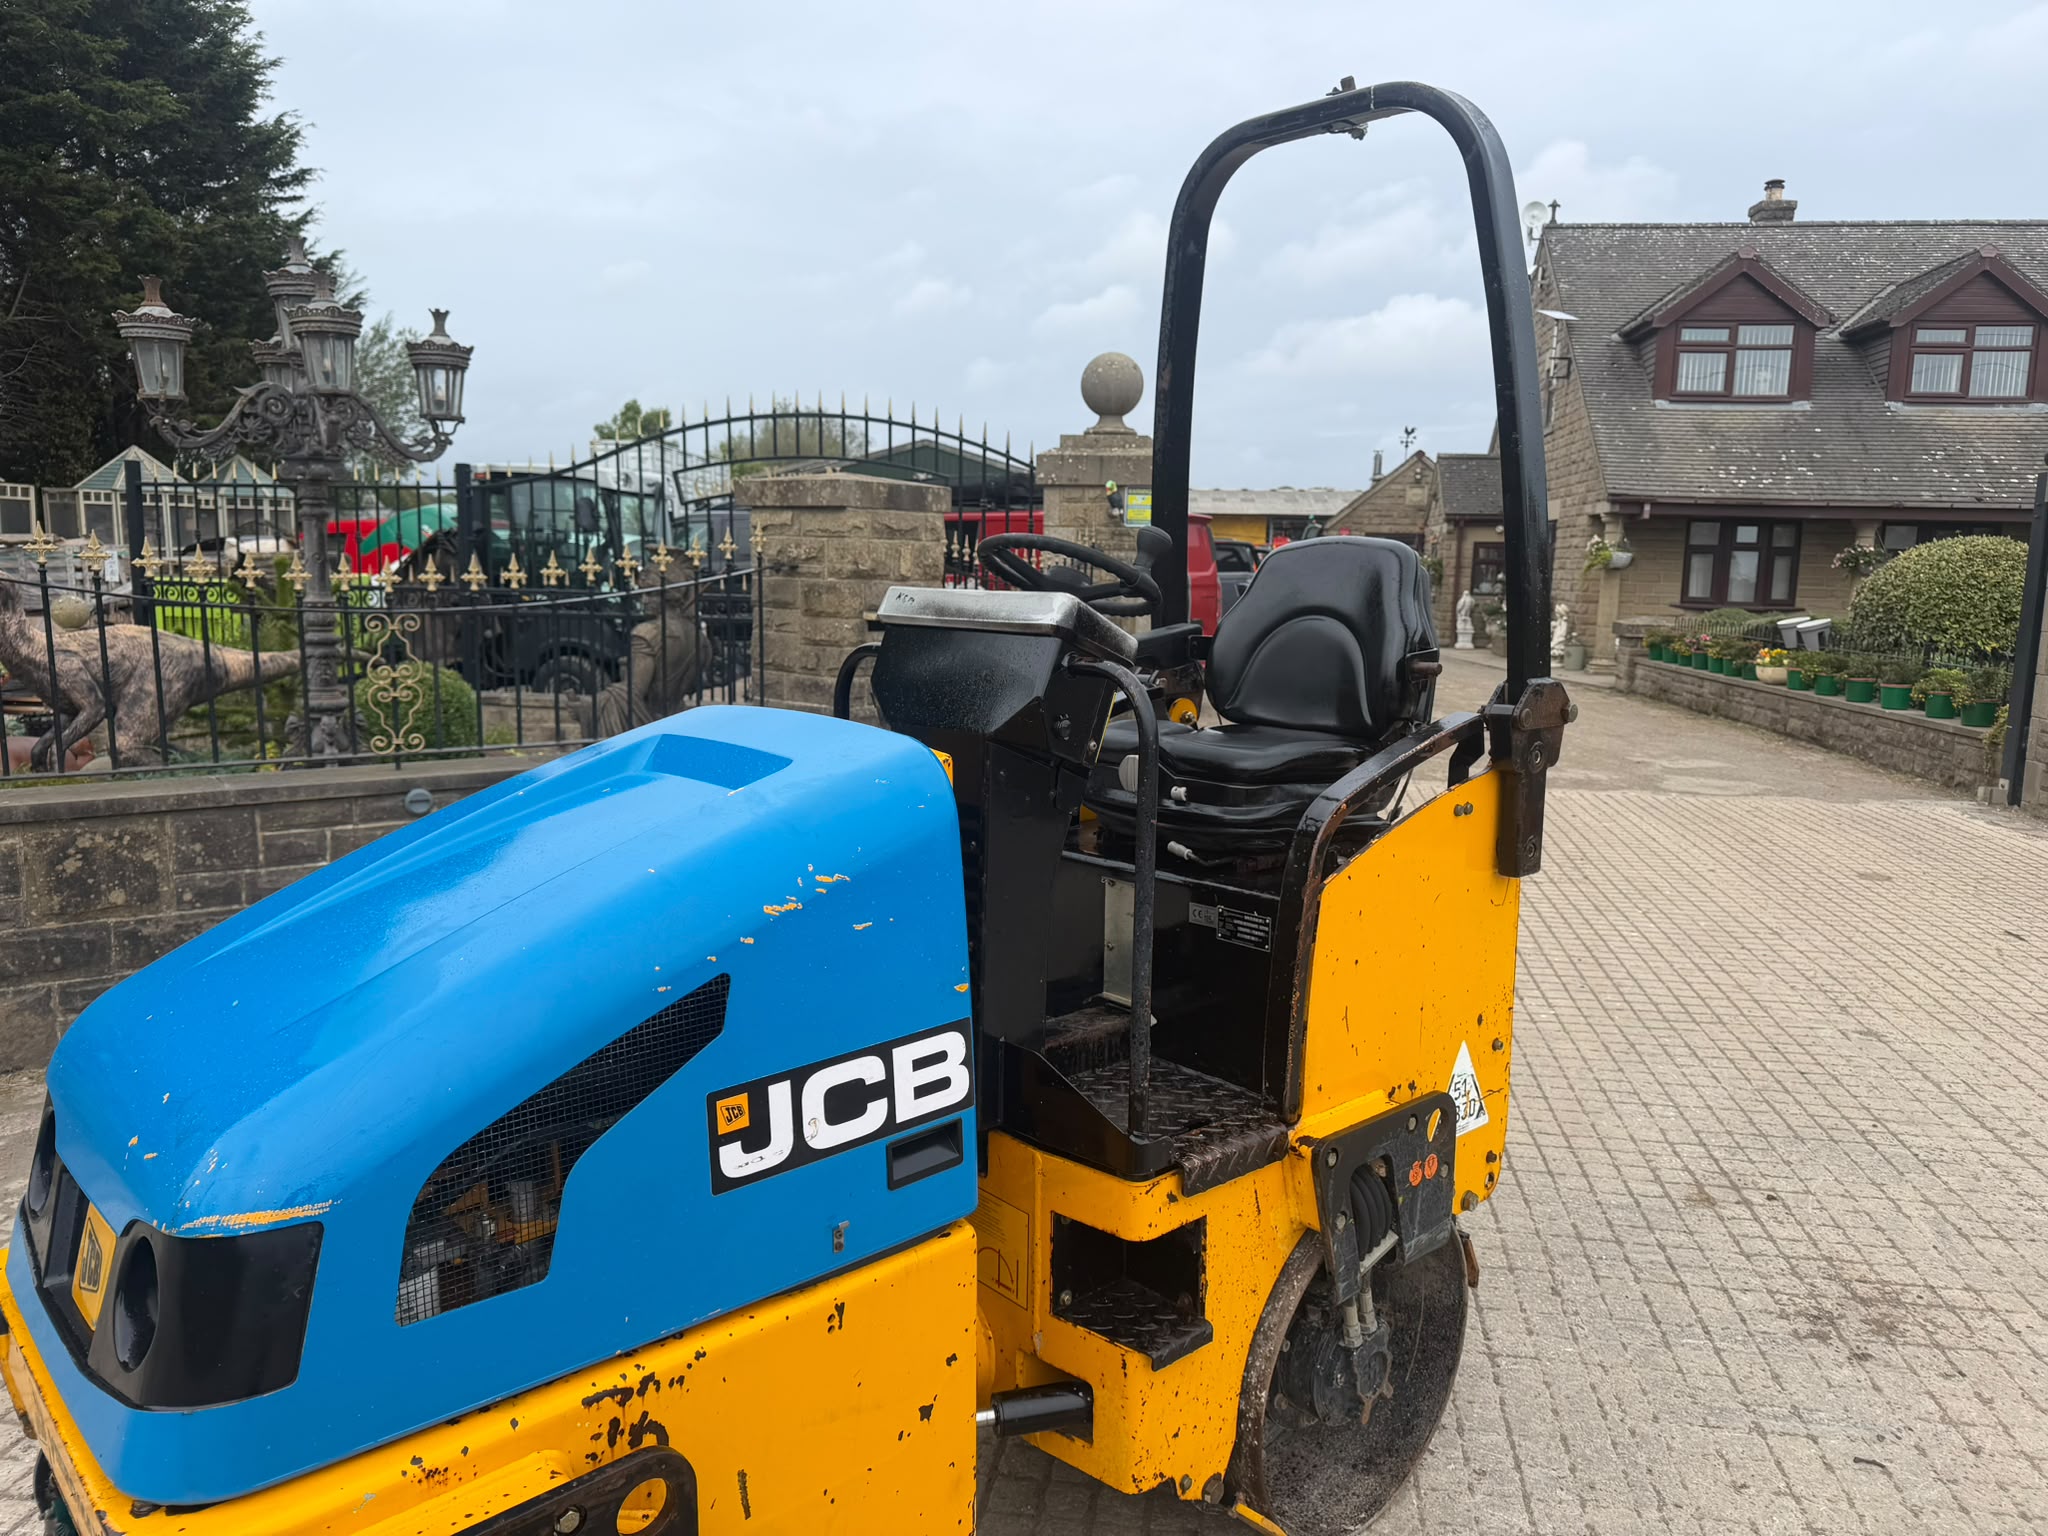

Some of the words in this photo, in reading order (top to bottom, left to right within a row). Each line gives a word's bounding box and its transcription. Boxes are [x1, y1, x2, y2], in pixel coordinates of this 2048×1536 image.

[718, 1030, 971, 1179] JCB
[725, 1105, 744, 1123] JCB
[81, 1229, 102, 1288] JCB
